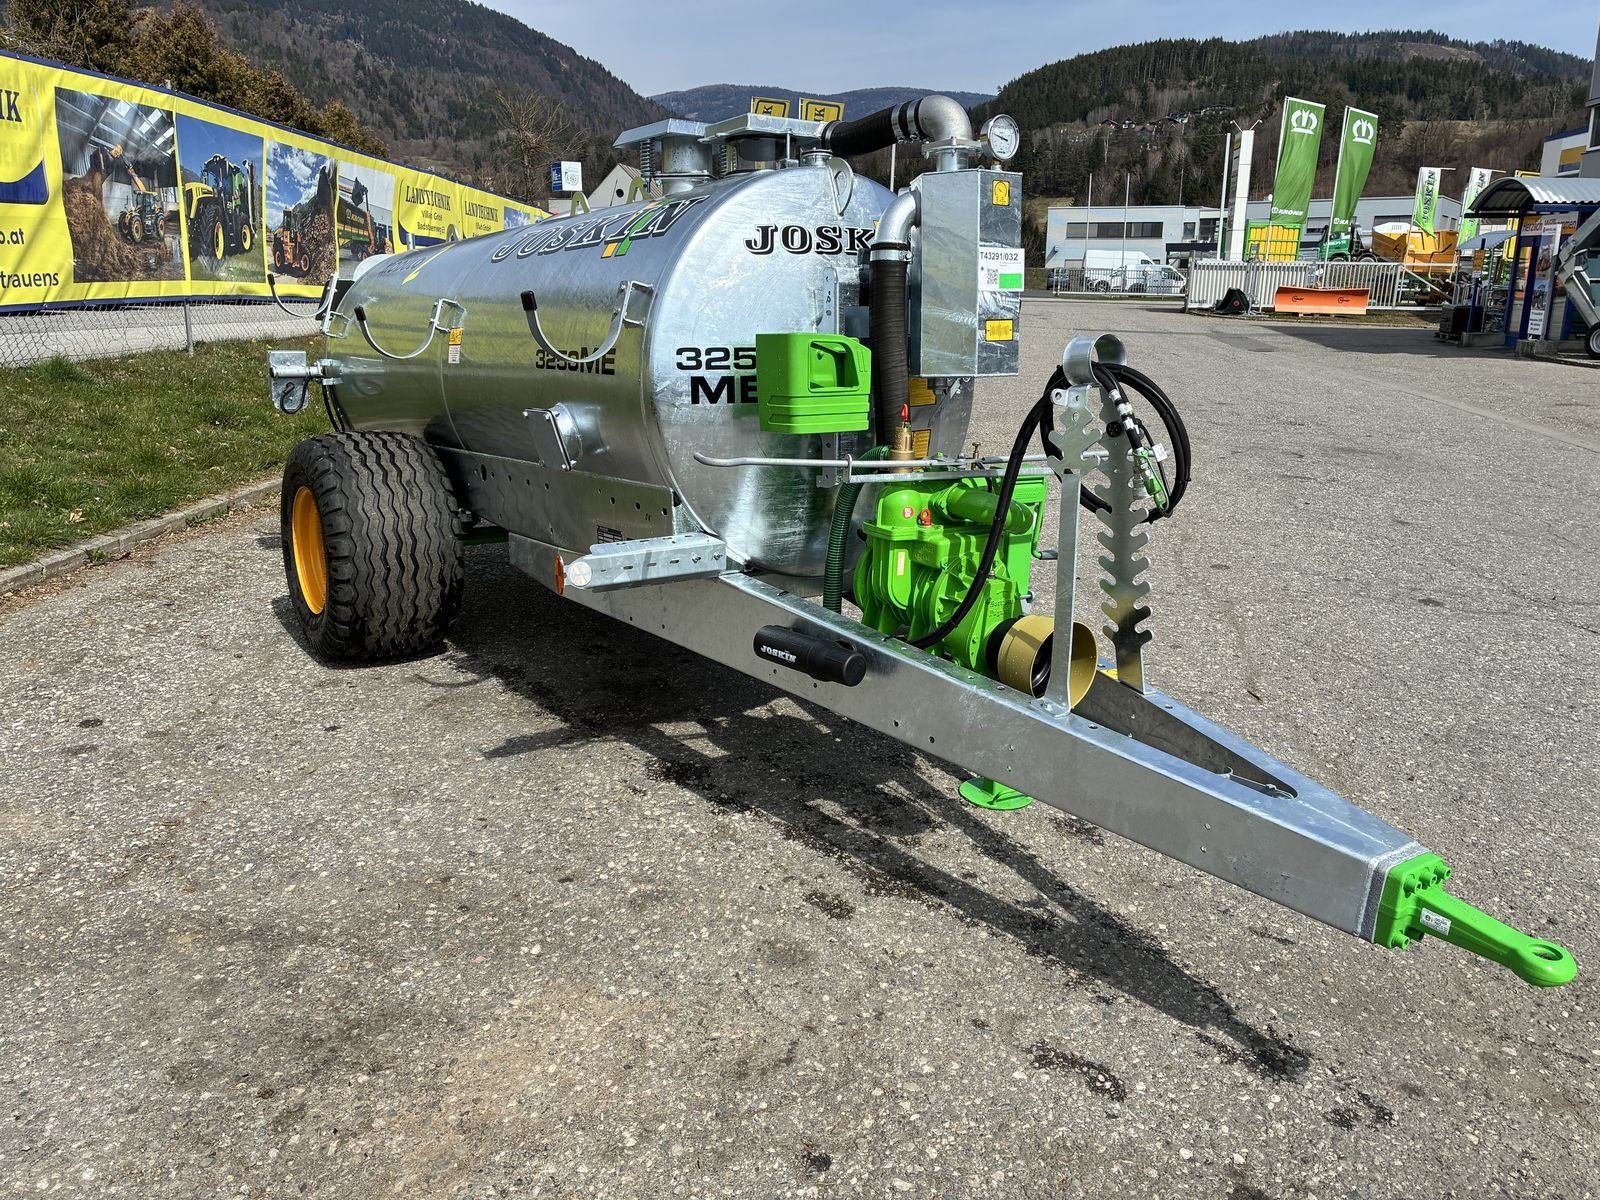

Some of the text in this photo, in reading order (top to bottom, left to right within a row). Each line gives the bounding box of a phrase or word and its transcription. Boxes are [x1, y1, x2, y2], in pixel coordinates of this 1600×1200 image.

[1422, 169, 1436, 223] JOSKIN
[491, 195, 710, 263] JOSKIN
[980, 251, 1019, 261] T43291/032
